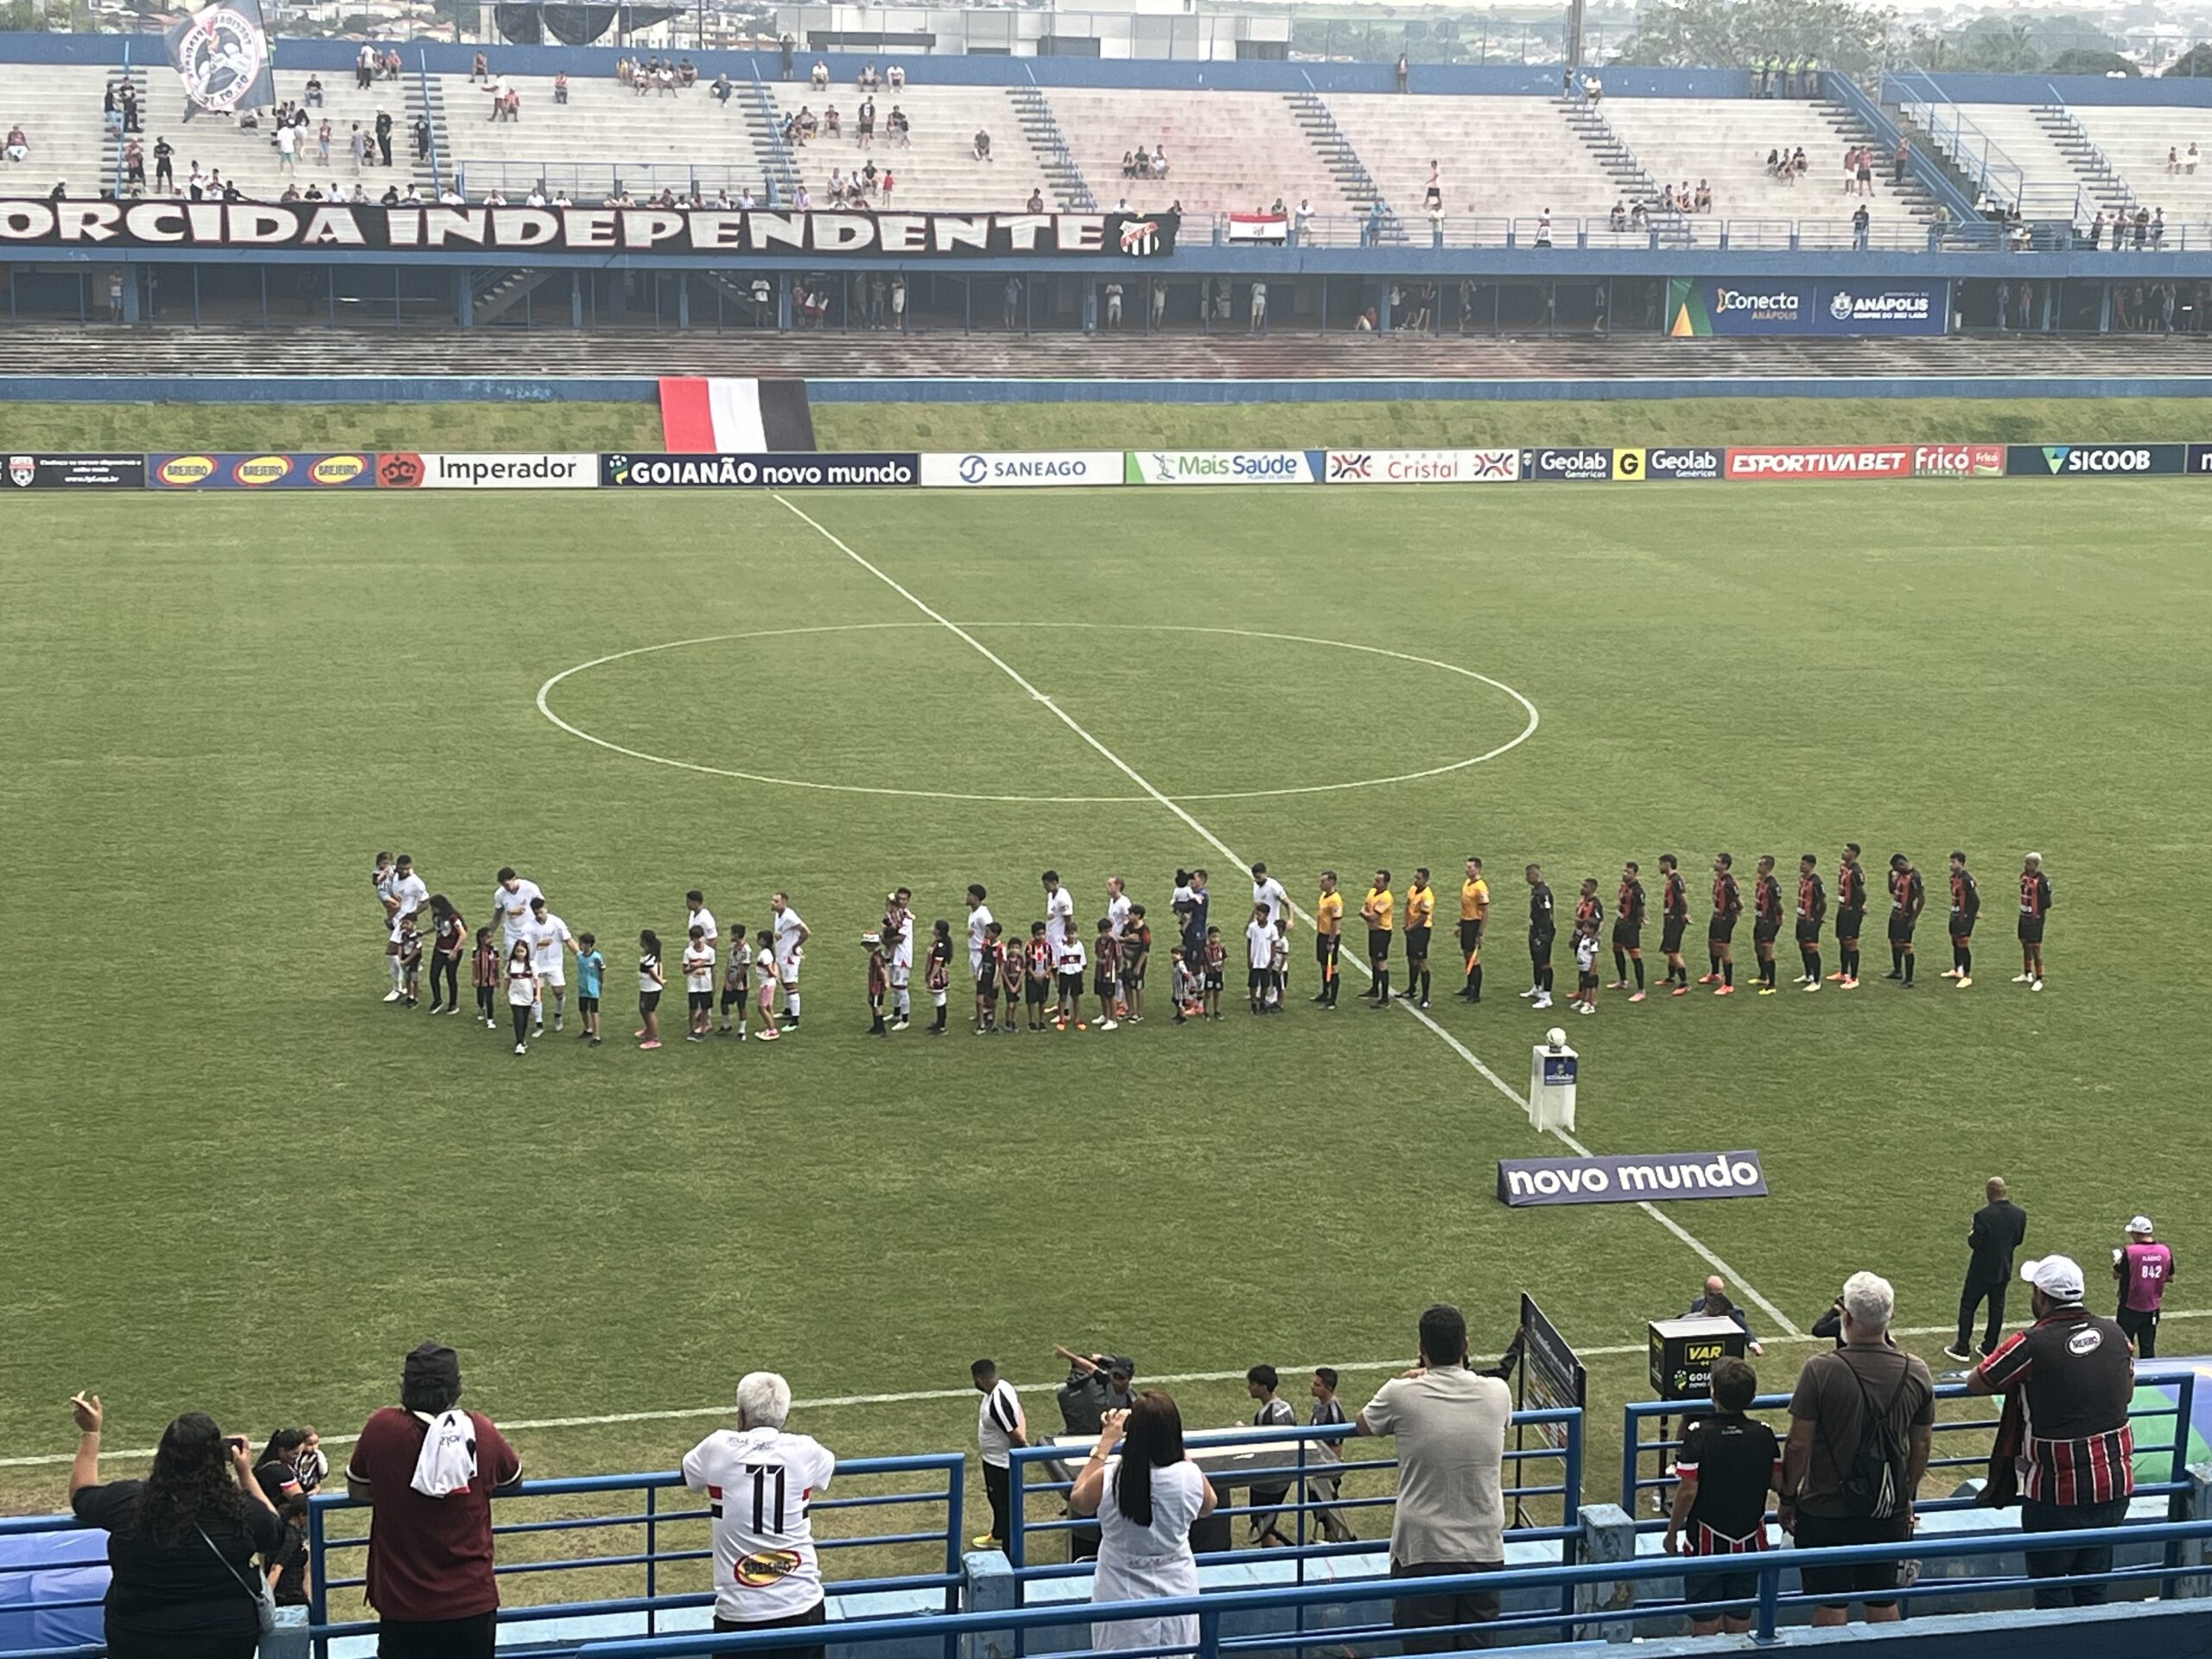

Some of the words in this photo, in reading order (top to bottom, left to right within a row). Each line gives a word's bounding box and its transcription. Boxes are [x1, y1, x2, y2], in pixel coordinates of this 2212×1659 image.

[386, 207, 1105, 251] INDEPENDENTE
[1725, 290, 1798, 309] Conecta
[1853, 296, 1929, 311] ANÁPOLIS
[994, 461, 1087, 477] SANEAGO
[1179, 454, 1230, 475] Mais
[1232, 454, 1297, 475] Saúde
[1388, 461, 1459, 479] Cristal
[1541, 450, 1607, 471] Geolab
[1619, 453, 1638, 475] G
[1651, 450, 1717, 469] Geolab
[1732, 453, 1906, 473] ESPORTIVABET
[2069, 450, 2151, 471] SICOOB
[439, 456, 576, 485] Imperador
[631, 457, 758, 484] GOIANÃO
[762, 466, 822, 484] novo
[828, 461, 912, 484] mundo
[1508, 1166, 1609, 1196] novo
[1617, 1154, 1759, 1190] mundo
[2141, 1265, 2163, 1279] 842
[1688, 1345, 1722, 1361] VAR
[746, 1464, 785, 1535] 11
